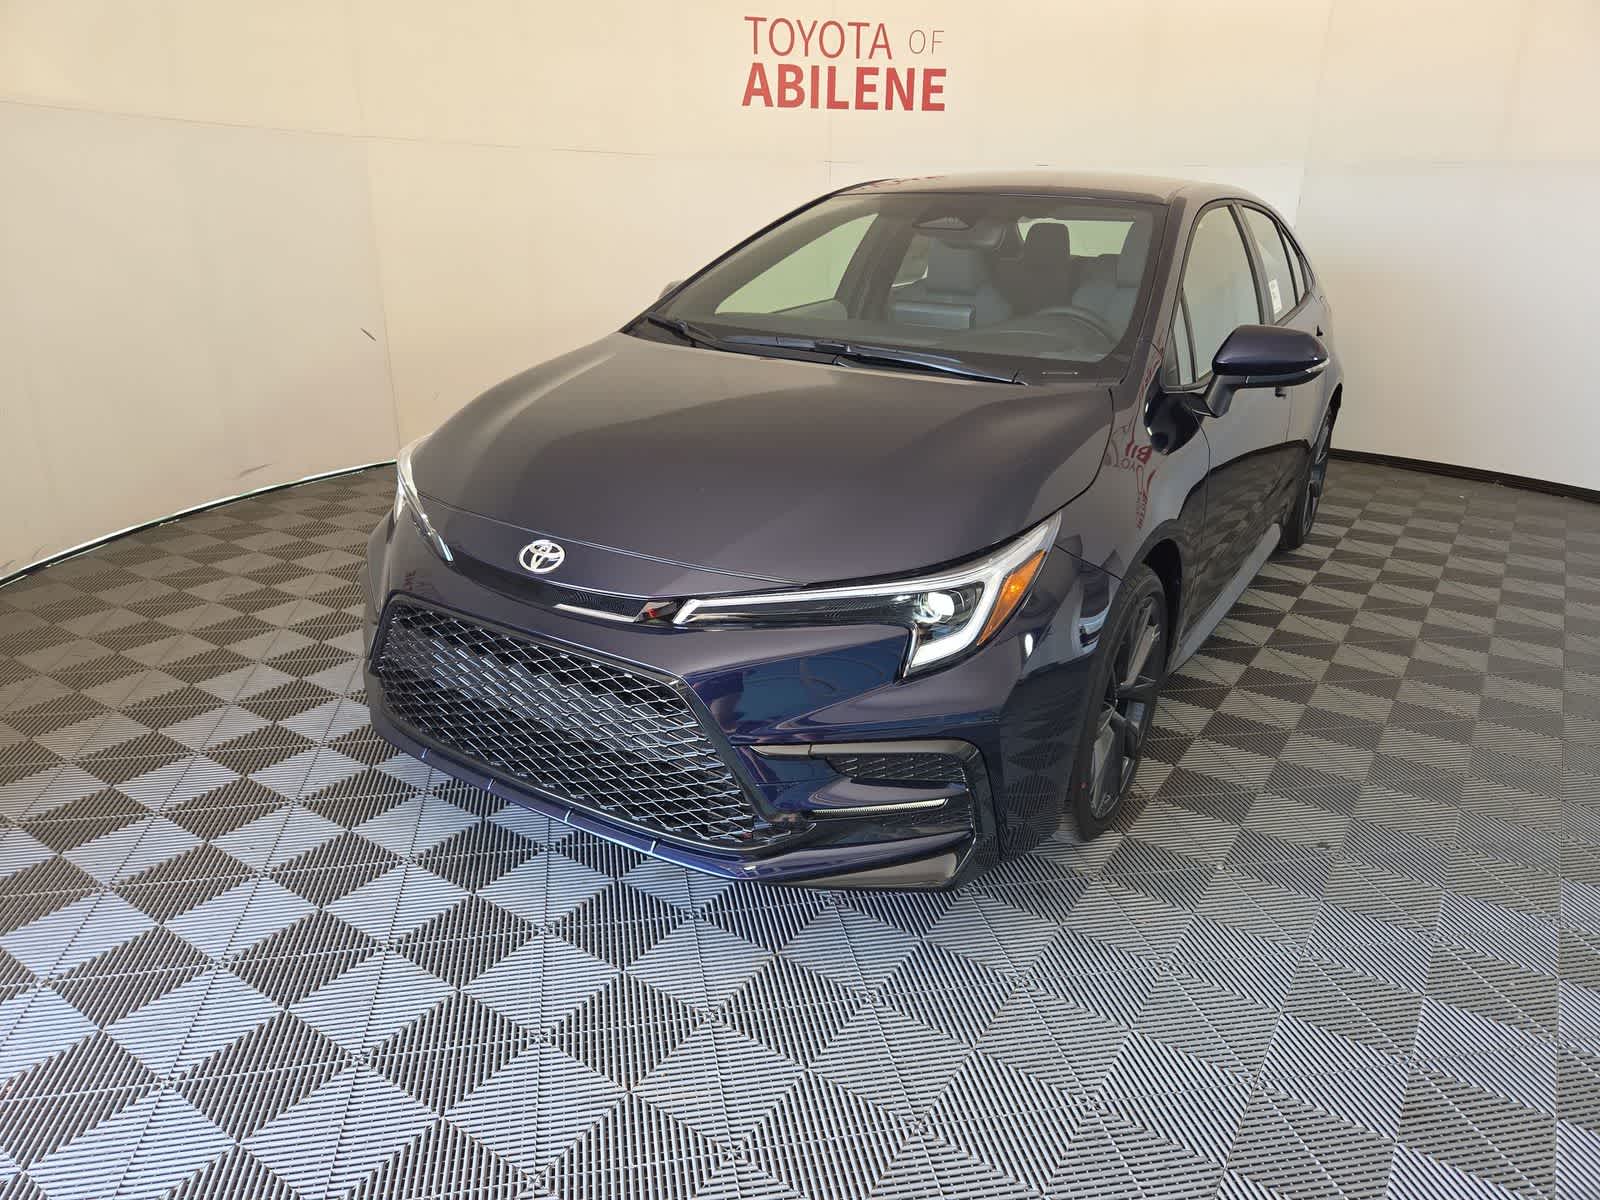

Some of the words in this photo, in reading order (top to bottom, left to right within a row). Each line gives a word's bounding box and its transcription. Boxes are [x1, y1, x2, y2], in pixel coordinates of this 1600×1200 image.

[744, 16, 892, 60] TOYOTA
[908, 29, 945, 55] OF
[741, 62, 947, 112] ABILENE
